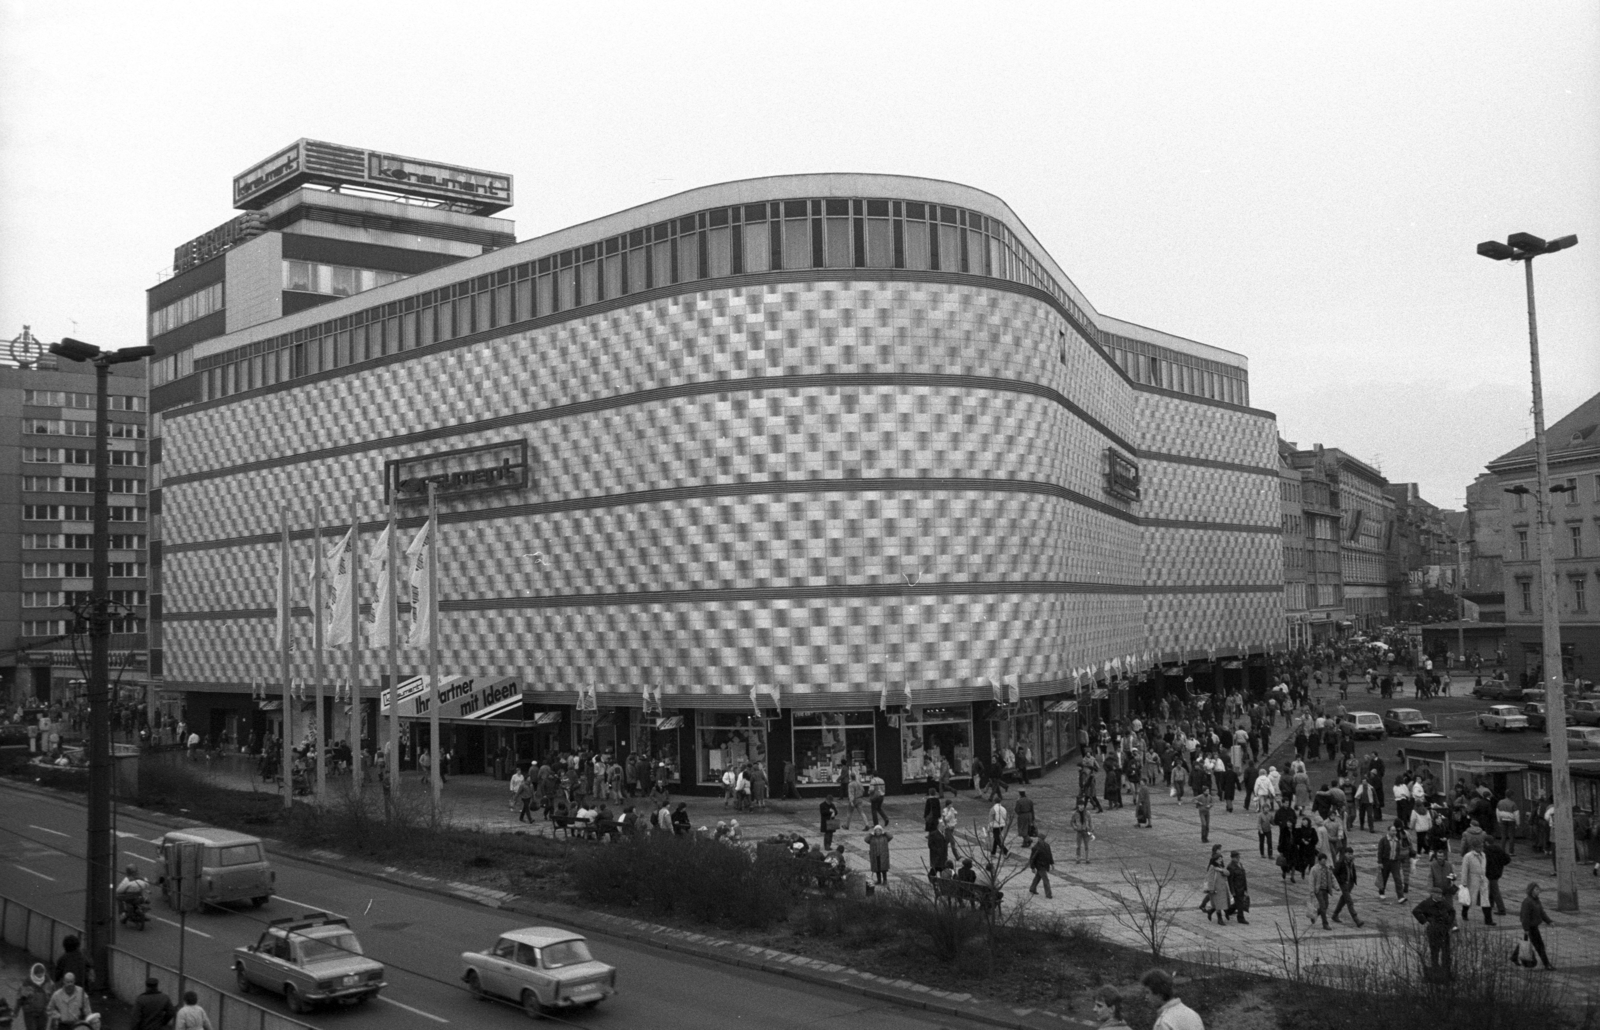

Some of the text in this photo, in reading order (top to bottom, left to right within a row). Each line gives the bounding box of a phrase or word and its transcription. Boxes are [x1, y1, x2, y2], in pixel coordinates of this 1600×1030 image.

[378, 155, 499, 195] konsument
[416, 695, 431, 714] Ihr
[461, 682, 518, 716] mit Ideen
